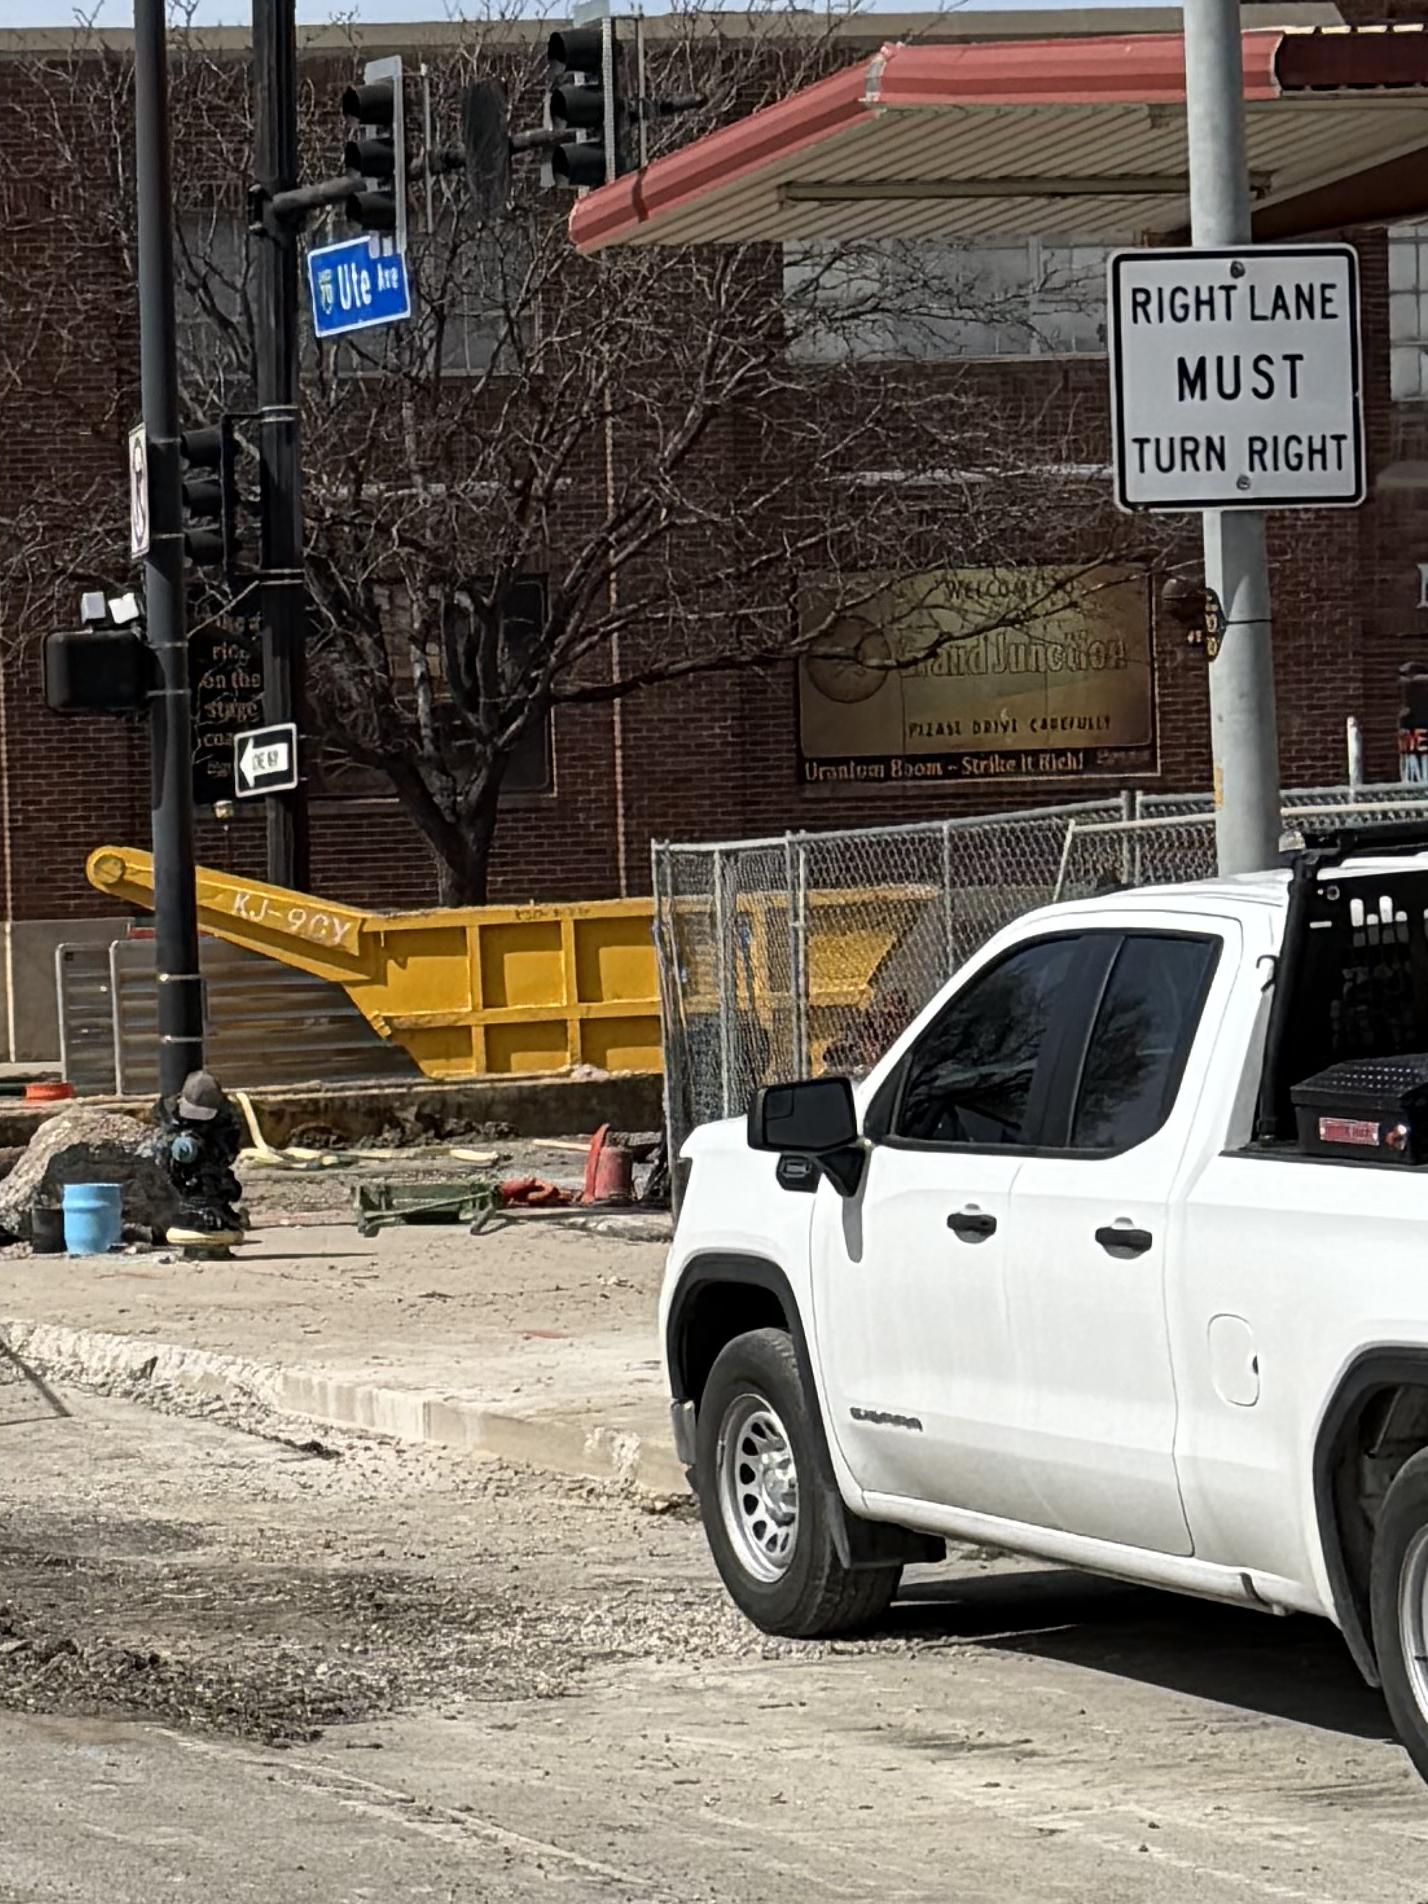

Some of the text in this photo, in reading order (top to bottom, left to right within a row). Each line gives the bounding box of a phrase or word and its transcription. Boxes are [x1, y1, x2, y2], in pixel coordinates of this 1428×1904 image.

[337, 262, 373, 310] Ute
[376, 262, 400, 293] Ave
[1131, 282, 1339, 325] RIGHT LANE
[1176, 353, 1304, 403] MUST
[1131, 433, 1348, 474] TURN RIGHT
[890, 758, 944, 779] Boom
[961, 755, 1017, 777] Strike
